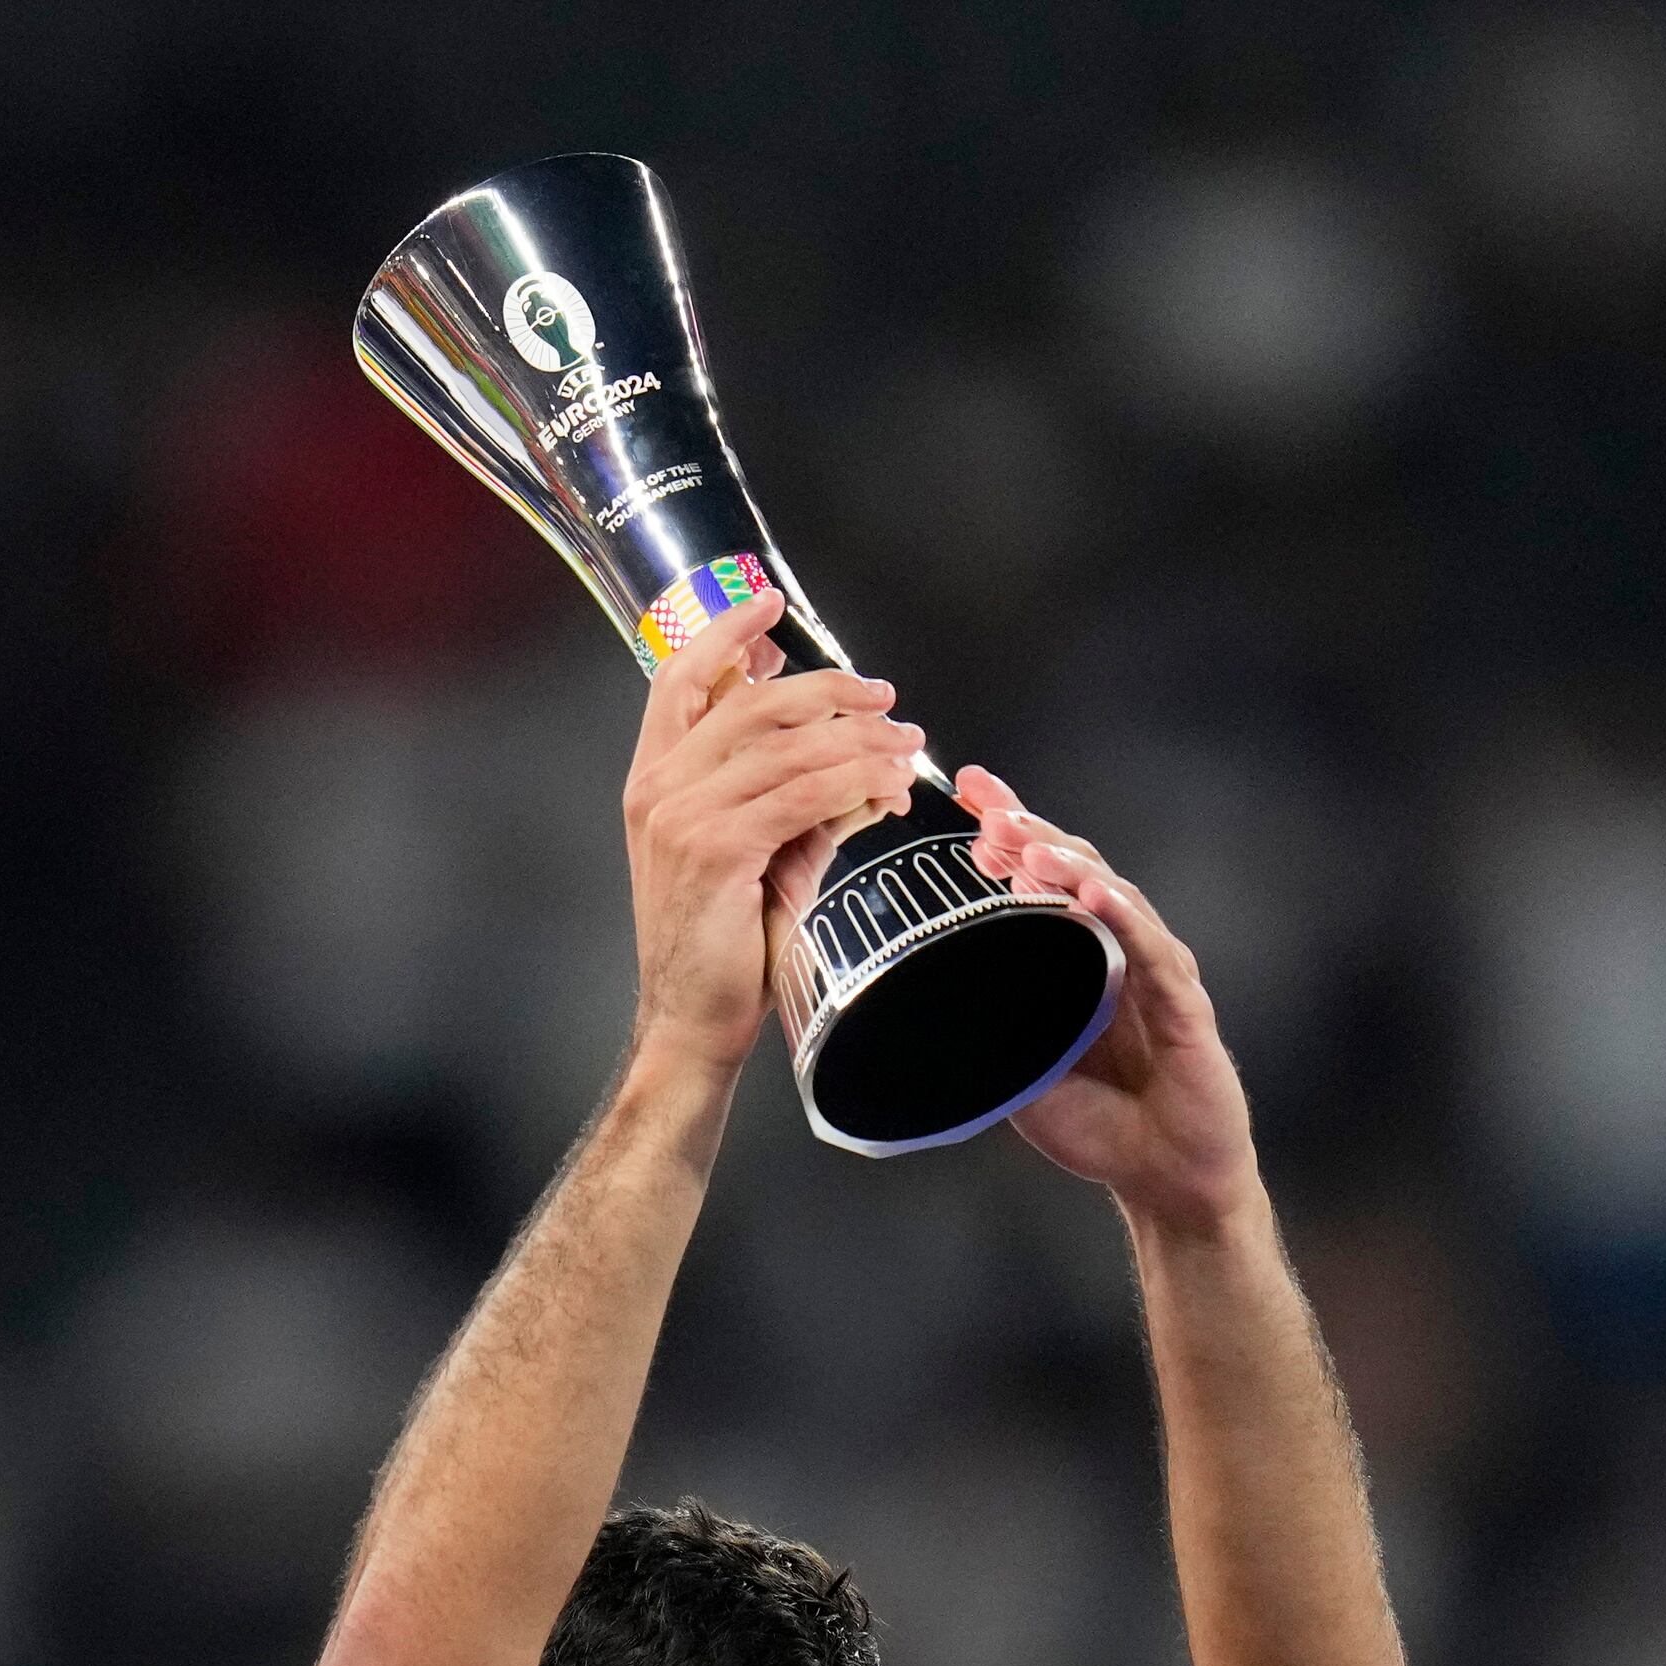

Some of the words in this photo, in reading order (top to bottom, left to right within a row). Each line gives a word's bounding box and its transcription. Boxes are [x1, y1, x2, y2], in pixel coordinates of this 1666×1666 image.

[561, 368, 603, 399] UEF
[573, 399, 635, 442] GERMANY
[596, 479, 649, 526] PLAYR
[646, 470, 667, 486] OF
[666, 463, 702, 477] THE
[606, 475, 703, 533] TOUAMENT
